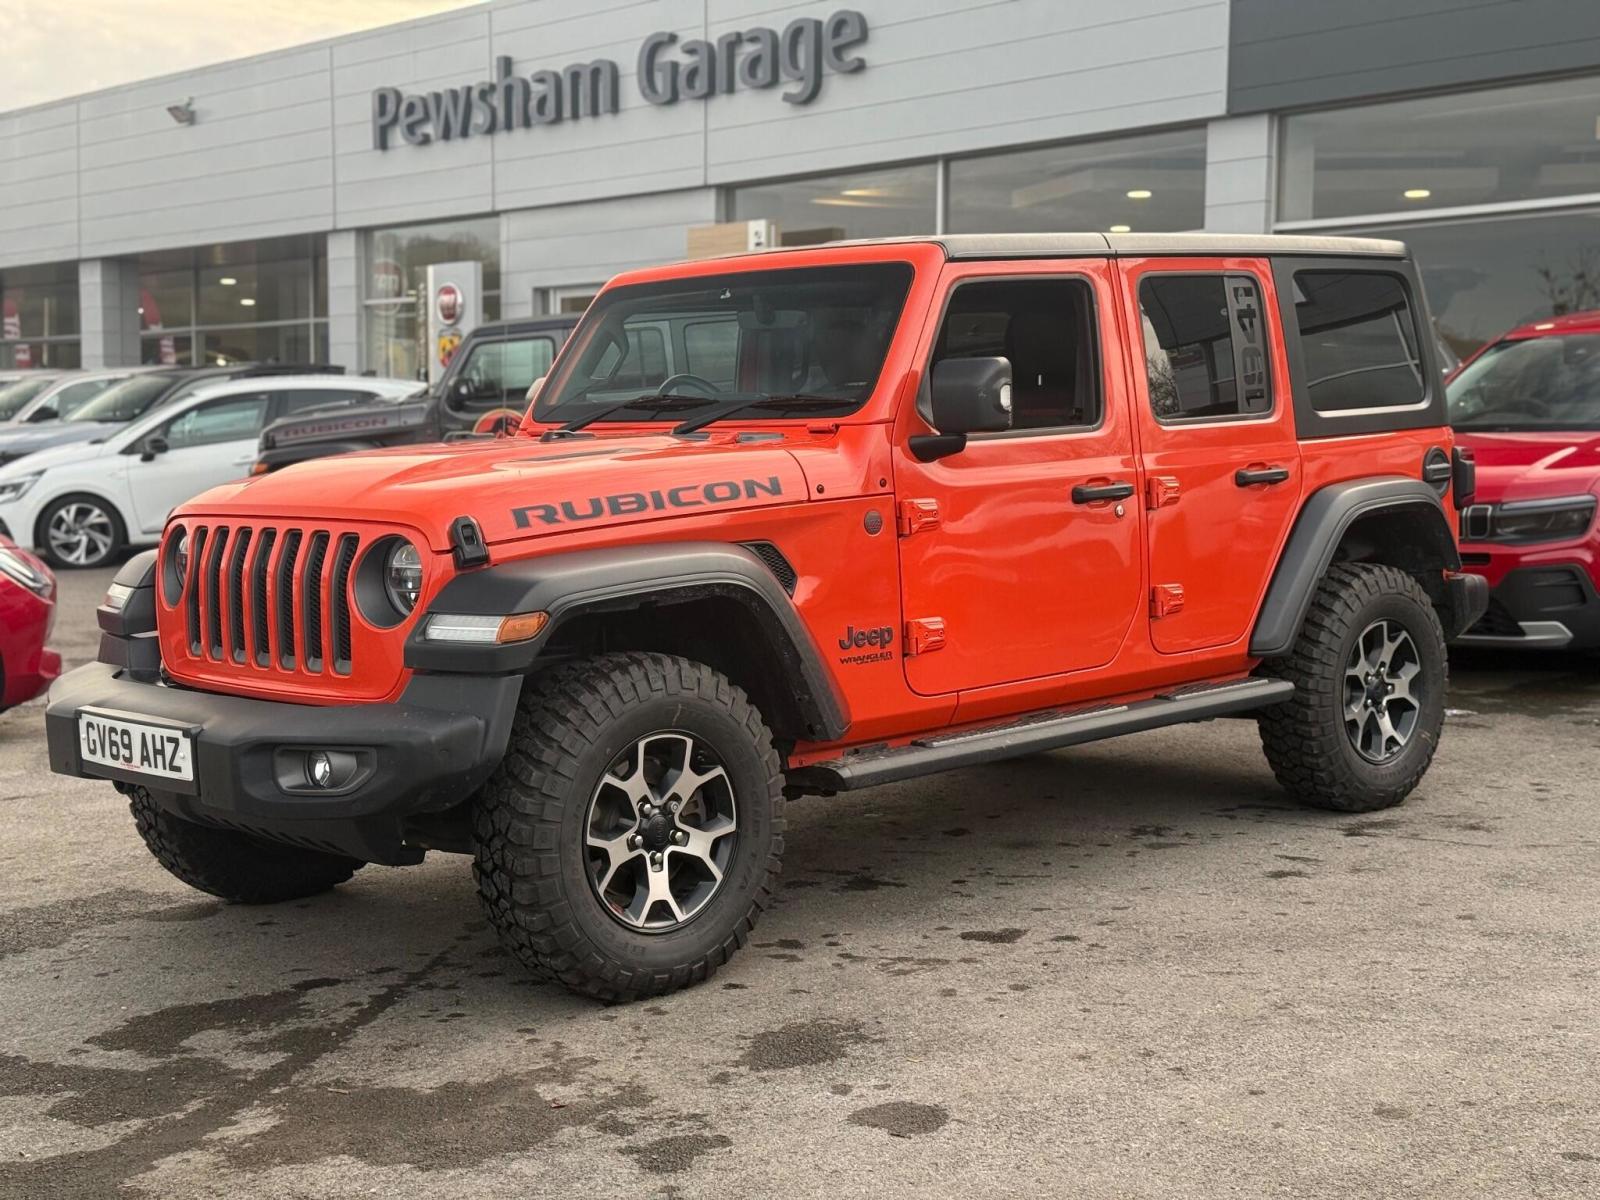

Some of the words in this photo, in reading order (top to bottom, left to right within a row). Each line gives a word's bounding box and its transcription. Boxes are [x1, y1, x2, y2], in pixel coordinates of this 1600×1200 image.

[372, 55, 619, 151] Pewsham
[637, 9, 868, 104] Garage
[1232, 286, 1265, 408] 1941
[283, 418, 387, 437] RUBICON
[510, 476, 783, 529] RUBICON
[838, 625, 893, 650] Jeep
[86, 721, 133, 764] GV69
[140, 732, 182, 773] AHZ
